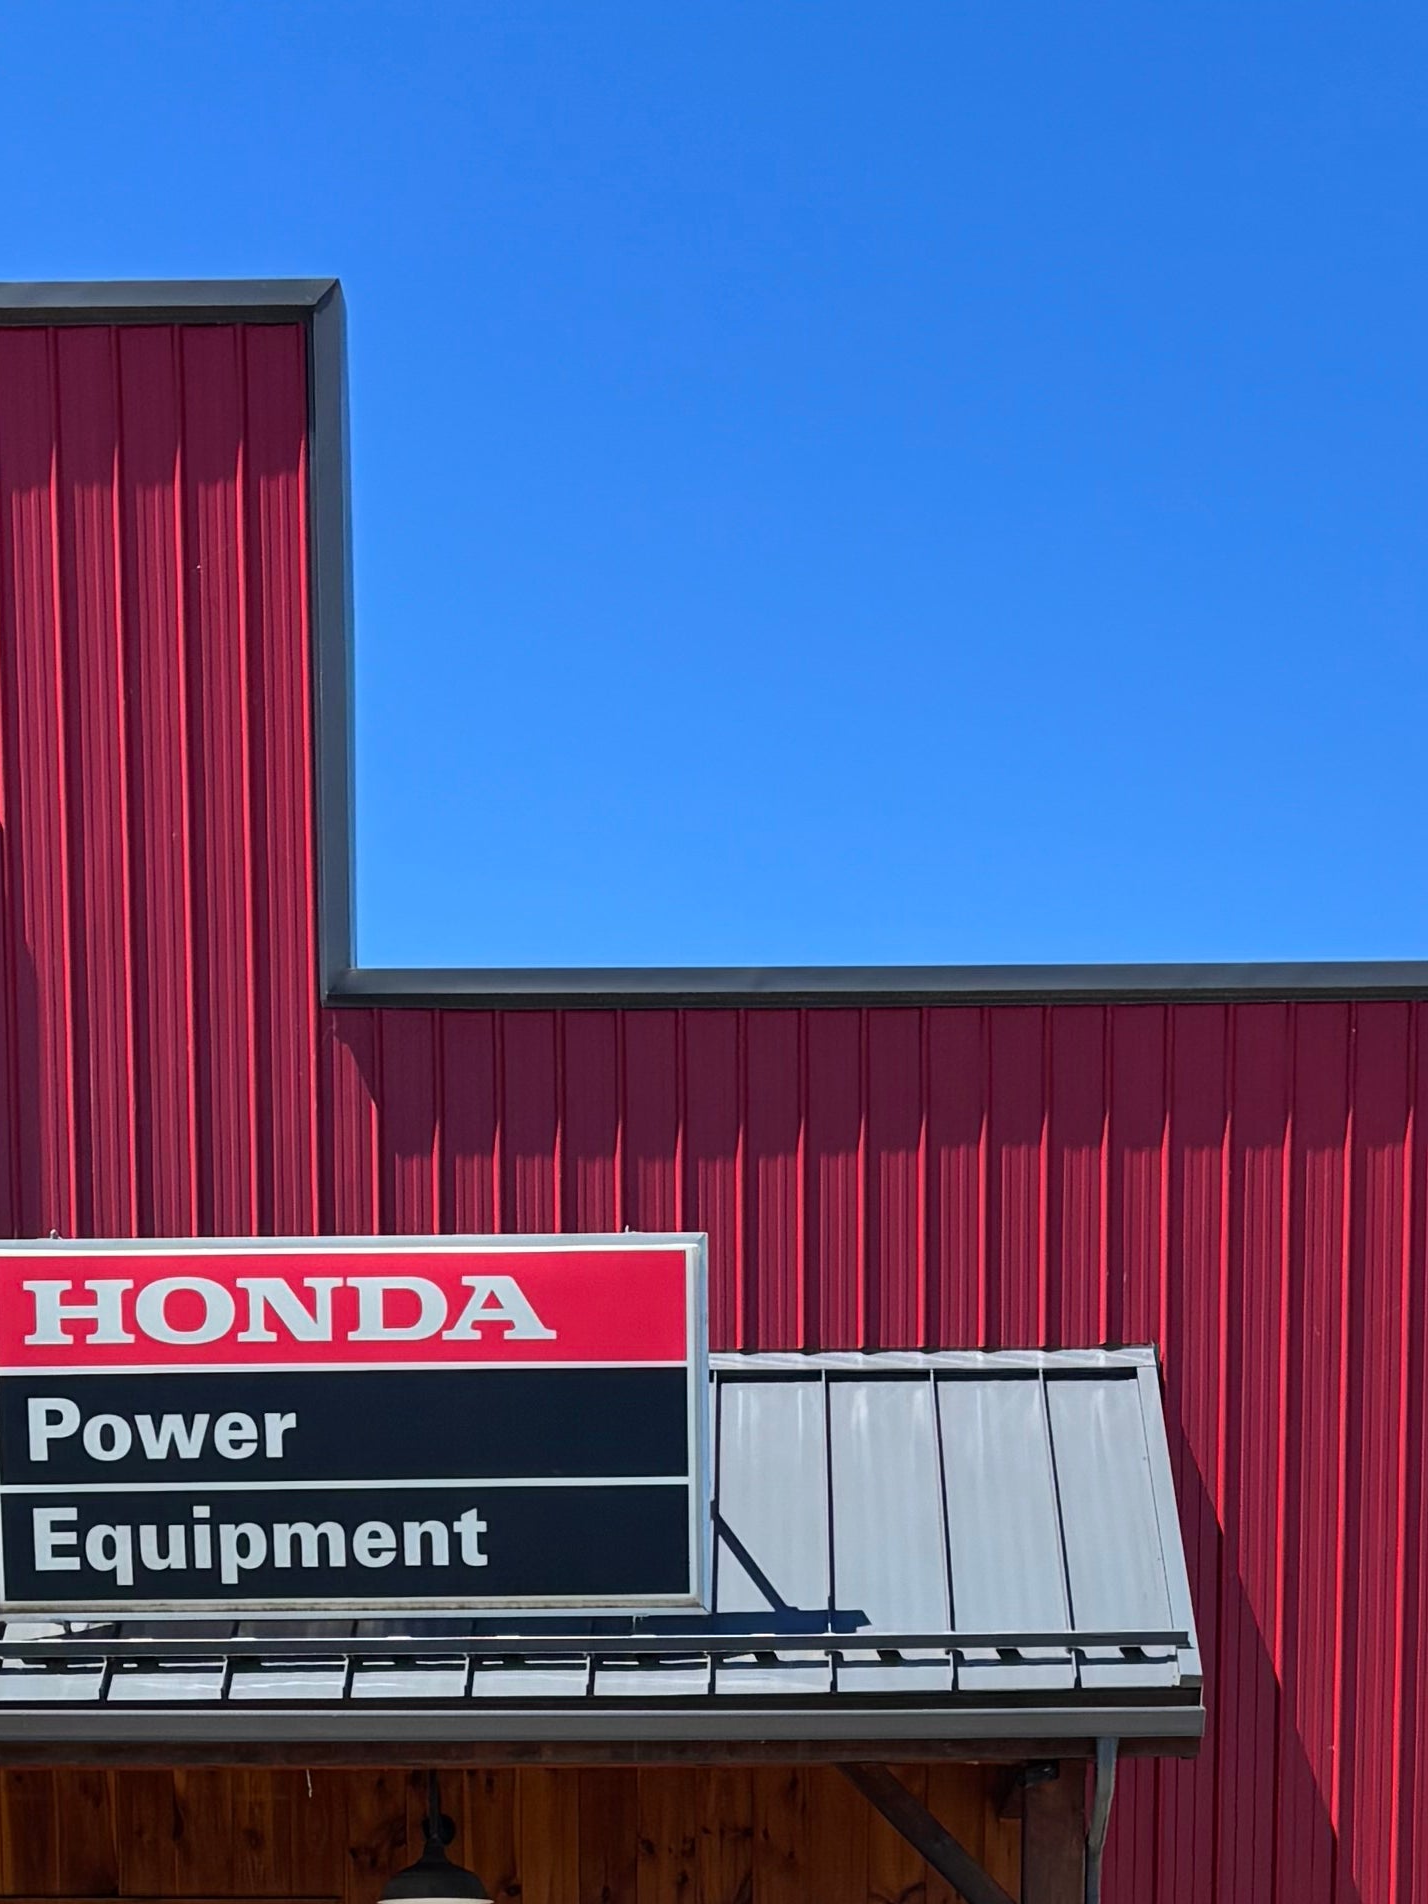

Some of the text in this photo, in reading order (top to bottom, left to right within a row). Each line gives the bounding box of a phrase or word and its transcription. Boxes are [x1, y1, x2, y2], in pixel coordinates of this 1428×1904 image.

[22, 1275, 558, 1346] HONDA
[27, 1397, 298, 1462] Power
[32, 1505, 489, 1586] Equipment
